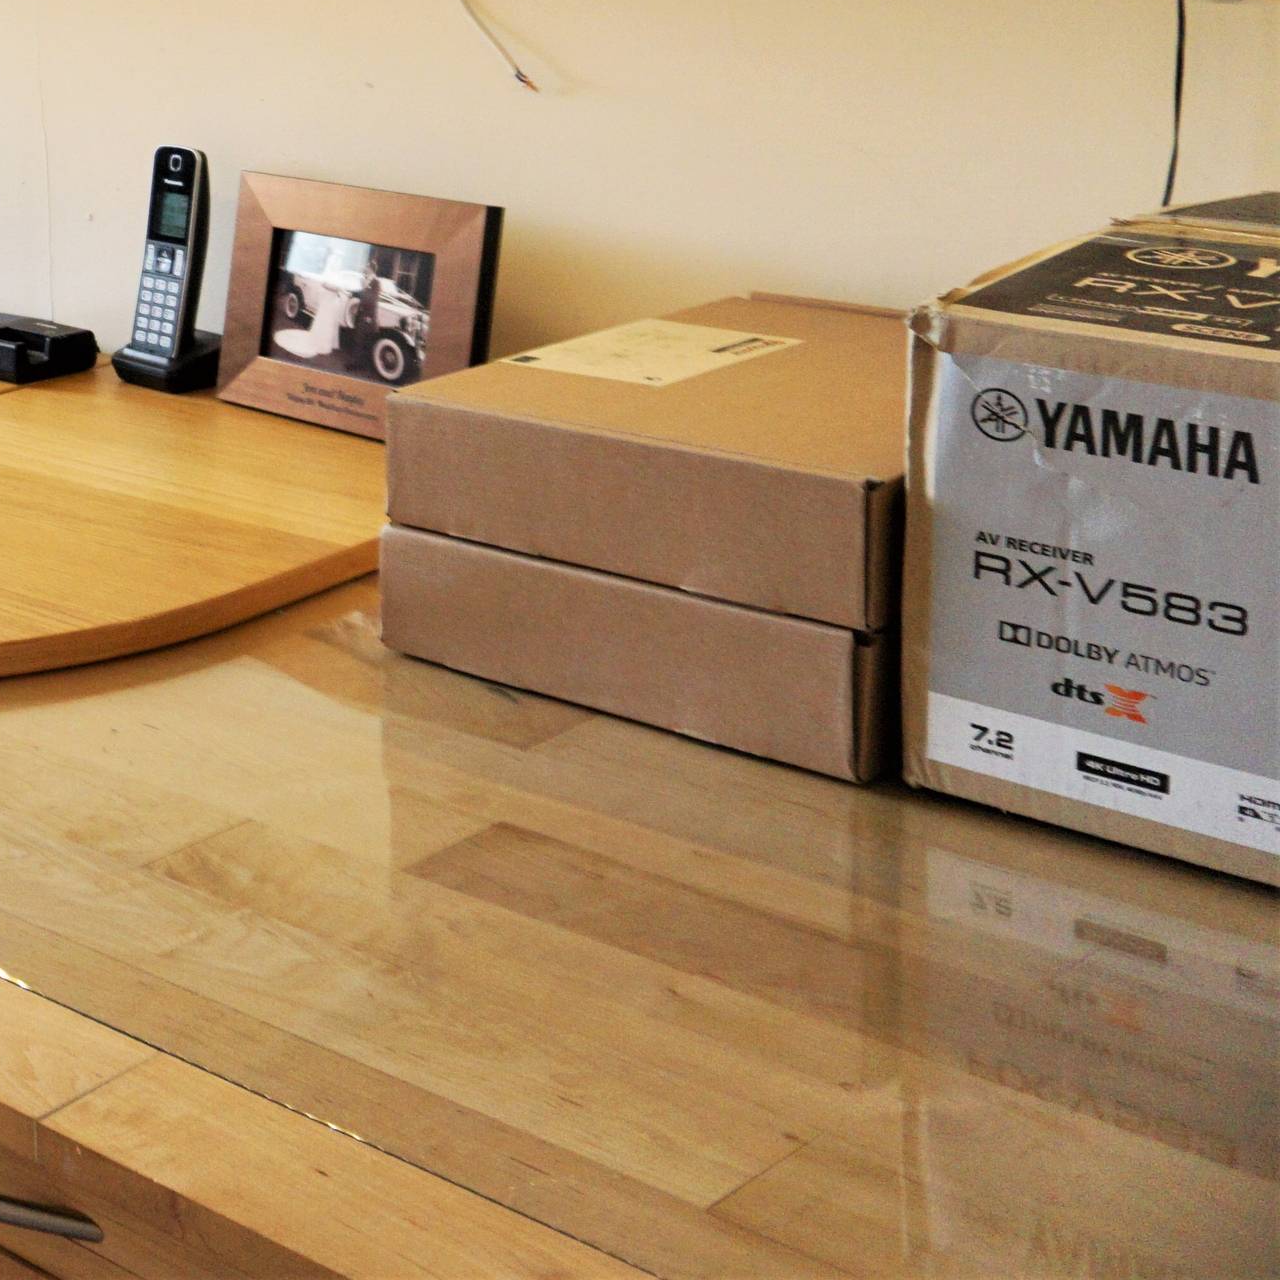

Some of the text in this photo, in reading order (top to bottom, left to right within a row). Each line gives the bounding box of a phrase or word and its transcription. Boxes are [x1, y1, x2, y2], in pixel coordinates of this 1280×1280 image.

[1035, 398, 1261, 484] YAMAHA
[975, 530, 1094, 566] AV RECEIVER
[972, 549, 1250, 637] RX-V583
[1036, 630, 1212, 688] DOLBY ATMOS
[968, 743, 1014, 761] channel
[969, 721, 1015, 751] 7.2
[1141, 773, 1162, 787] HD
